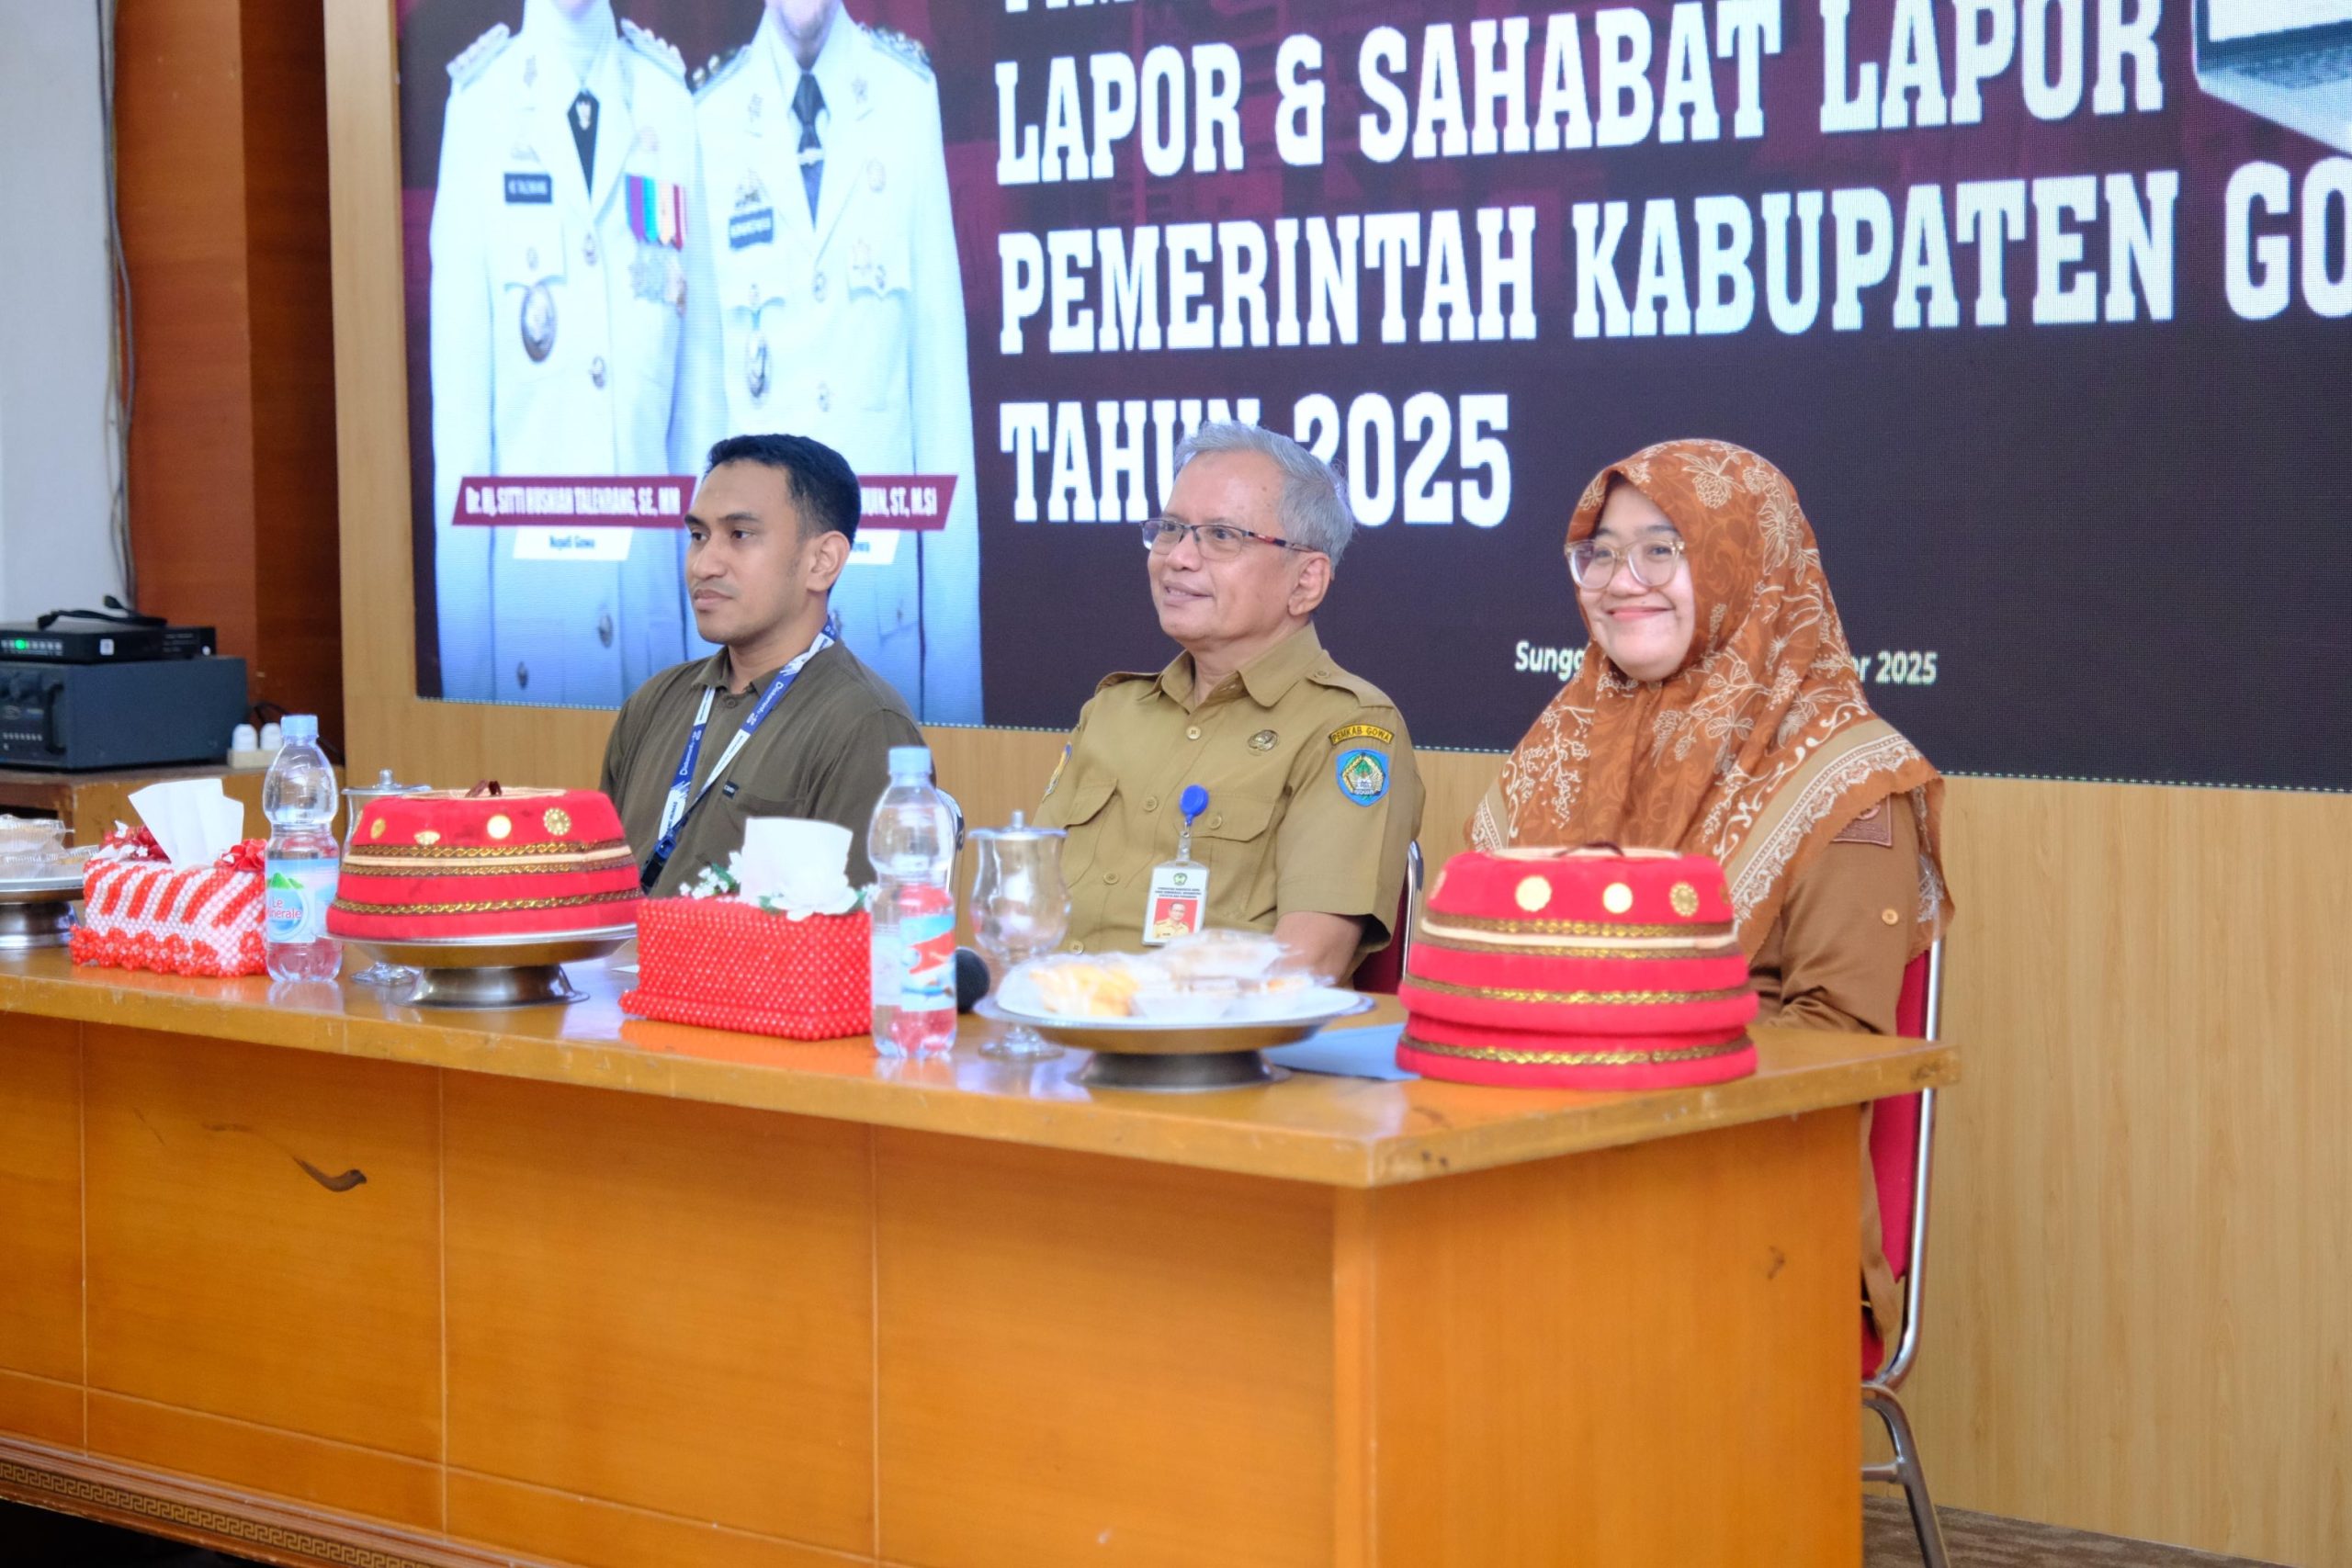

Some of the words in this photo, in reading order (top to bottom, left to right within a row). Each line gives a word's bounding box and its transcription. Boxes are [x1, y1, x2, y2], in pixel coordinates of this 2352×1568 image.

[995, 43, 1244, 185] LAPOR
[1275, 34, 1325, 166] &
[1359, 0, 1781, 162] SAHABAT
[1820, 0, 2163, 133] LAPOR
[998, 206, 1537, 355] PEMERINTAH
[1572, 171, 2178, 338] KABUPATEN
[1000, 399, 1260, 523] TAHU
[1294, 392, 1511, 527] 2025
[1332, 726, 1362, 742] PEMKAB
[1366, 727, 1389, 741] GOWA
[1875, 649, 1939, 685] 2025
